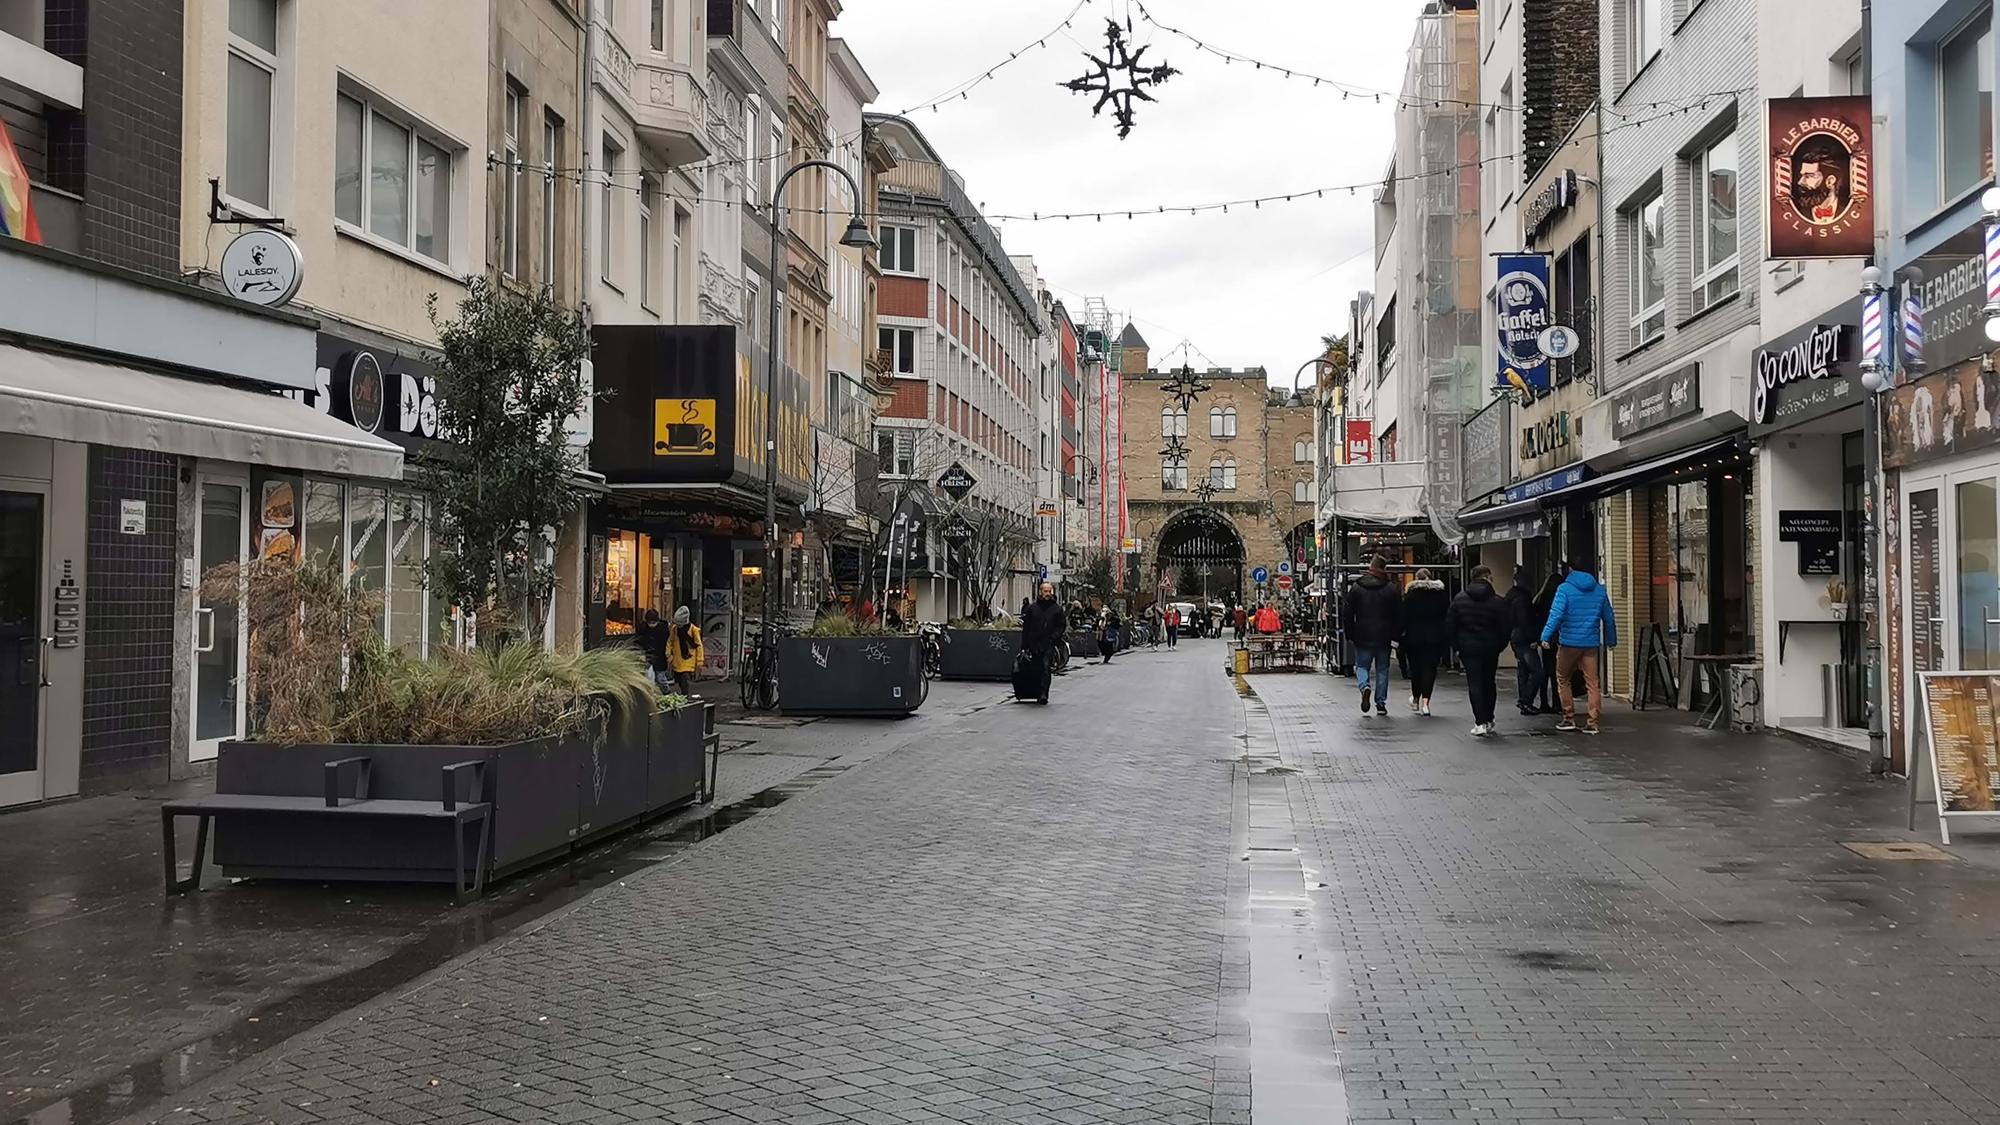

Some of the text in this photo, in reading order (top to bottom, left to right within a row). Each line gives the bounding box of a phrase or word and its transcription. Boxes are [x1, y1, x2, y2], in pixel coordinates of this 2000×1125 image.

[1782, 117, 1860, 146] LE BARBIER
[1782, 209, 1861, 238] CLASSIC
[1919, 253, 1986, 316] LE BARBIER
[1498, 307, 1548, 331] Gaffel
[1931, 303, 1973, 341] CLASSIC
[1778, 324, 1842, 380] CONCEPT
[735, 351, 810, 482] merenich
[1039, 501, 1055, 510] dm
